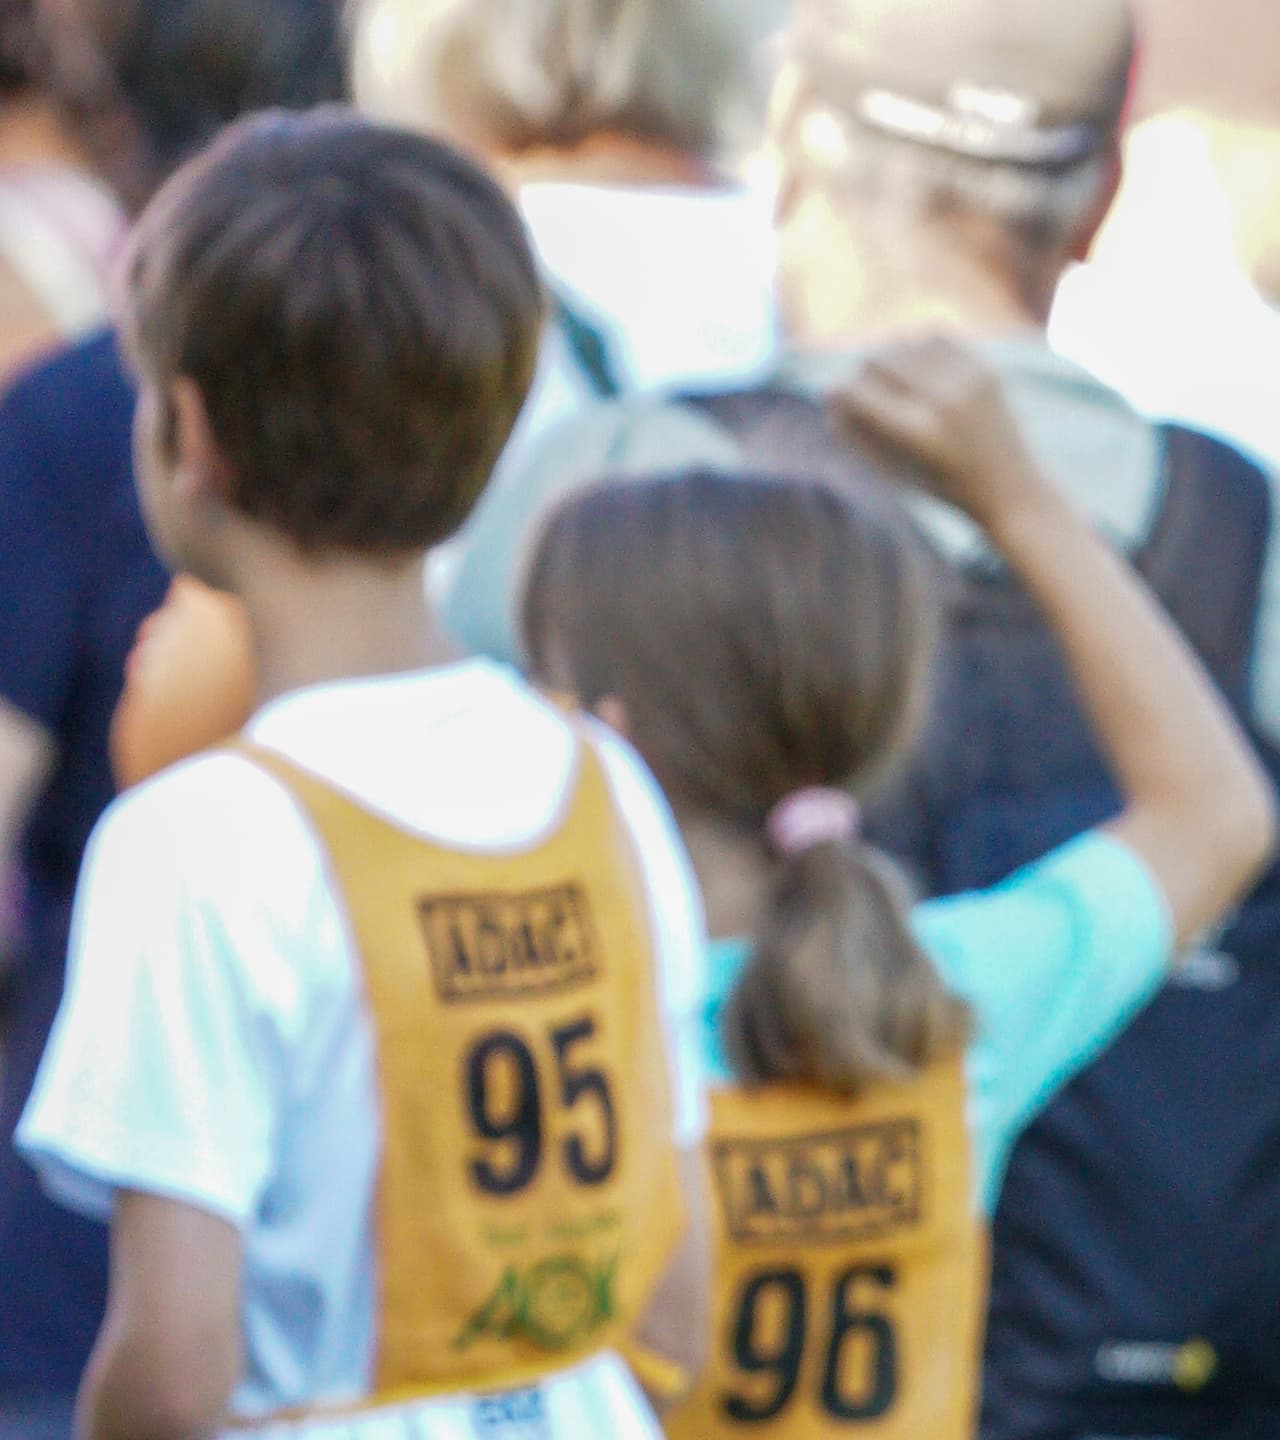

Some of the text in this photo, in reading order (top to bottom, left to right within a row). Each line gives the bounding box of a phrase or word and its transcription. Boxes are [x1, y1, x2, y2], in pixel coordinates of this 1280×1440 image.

[441, 898, 590, 985] ADAC
[463, 1015, 620, 1198] 95
[744, 1144, 914, 1228] ADAC
[716, 1259, 900, 1425] 96
